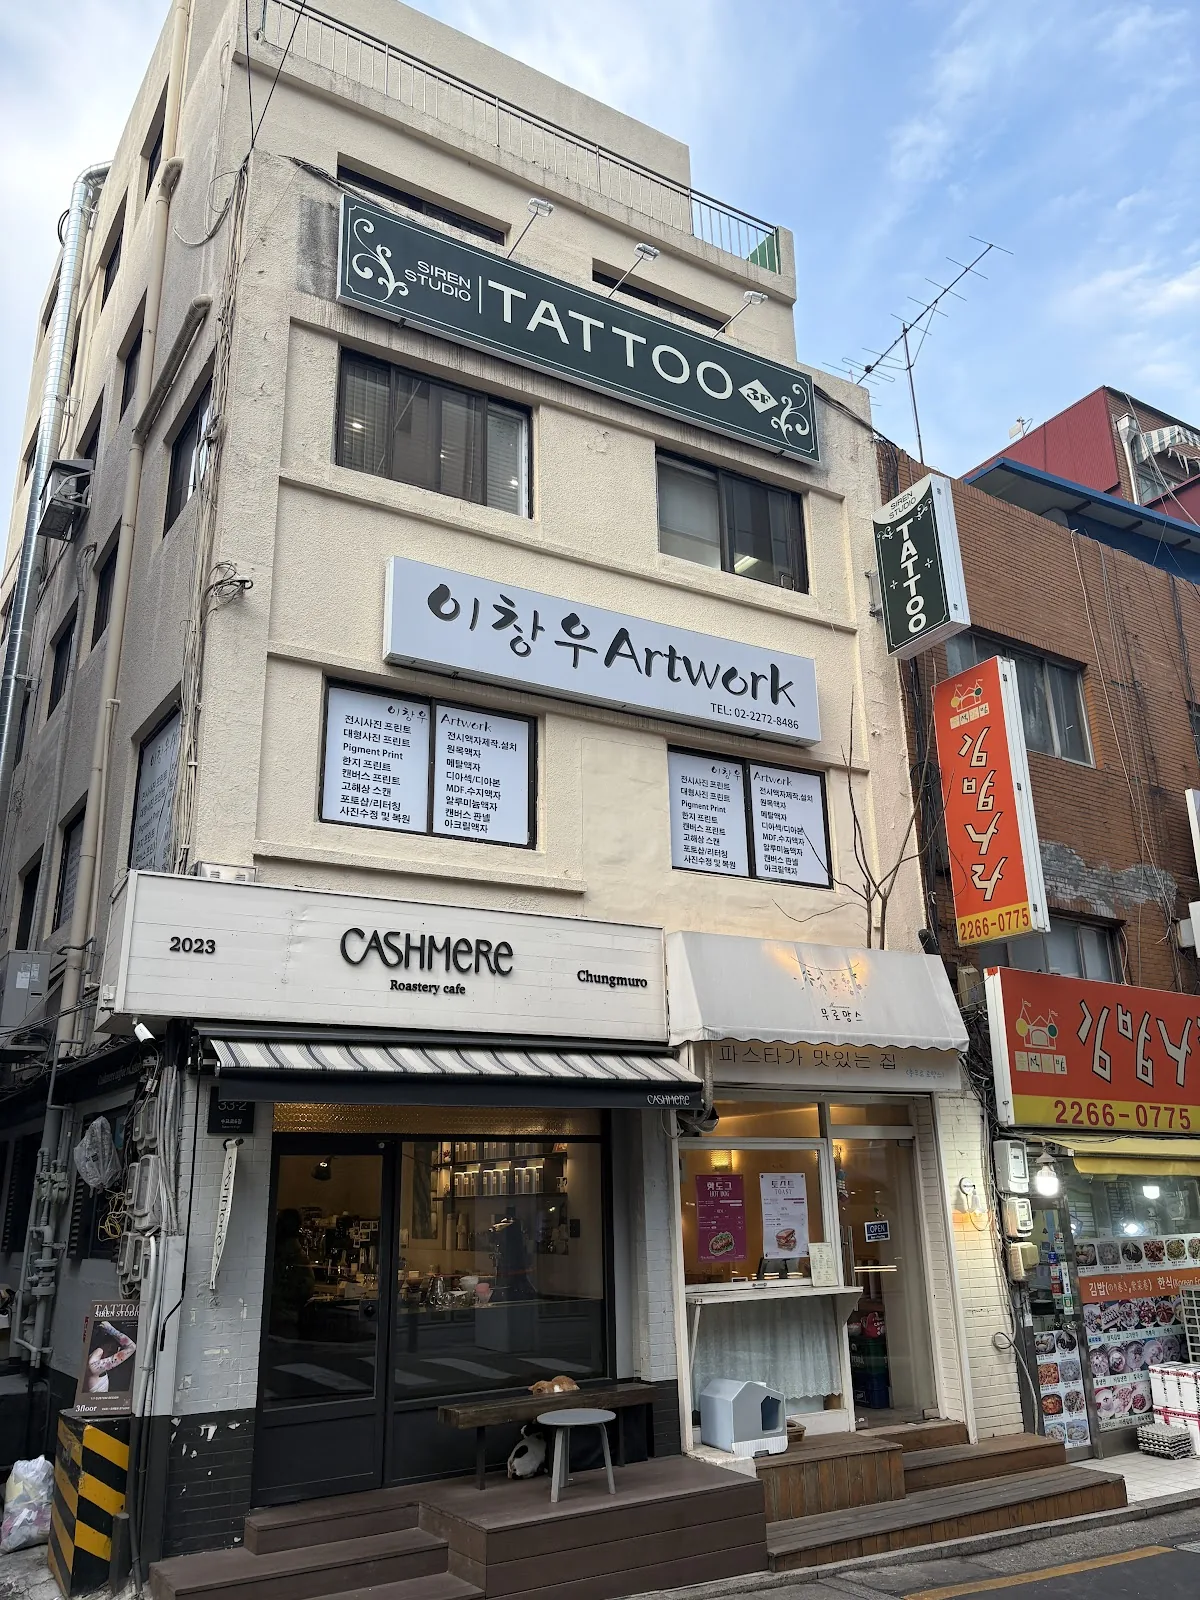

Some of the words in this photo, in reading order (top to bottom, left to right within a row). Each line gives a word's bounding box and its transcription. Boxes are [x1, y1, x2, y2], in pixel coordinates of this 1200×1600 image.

[417, 259, 471, 289] SIREN
[404, 269, 472, 303] STUDIO
[487, 279, 733, 401] TATTOO
[746, 386, 772, 405] 3F
[888, 497, 917, 520] STUDIO
[890, 490, 914, 510] SIREN
[896, 517, 927, 634] TATTOO
[427, 583, 598, 669] 이창우
[604, 627, 796, 708] Artwork
[388, 705, 428, 724] 이창우
[441, 713, 492, 732] Artwork
[710, 702, 731, 718] TEL:
[734, 708, 800, 730] 02-2272-8486
[345, 714, 382, 730] 전시사진
[384, 722, 412, 735] 프린트
[343, 728, 381, 743] 대형사진
[383, 735, 411, 748] 프린트
[343, 742, 380, 756] Pigment
[382, 749, 404, 760] Print
[342, 756, 361, 768] 한지
[363, 759, 391, 772] 프린트
[342, 768, 371, 781] 캔버스
[372, 773, 401, 785] 프린트
[681, 775, 708, 787] 전시사진
[710, 780, 730, 790] 프린트
[711, 766, 741, 781] 이창우
[754, 771, 793, 786] Artwork
[341, 781, 370, 794] 고해상
[372, 786, 392, 798] 스캔
[710, 792, 730, 802] 프린트
[340, 794, 401, 812] 포토샵/리터칭
[681, 799, 709, 811] Pigment
[710, 804, 726, 813] Print
[340, 806, 378, 820] 사진수정
[381, 811, 390, 822] 및
[445, 808, 471, 820] 캔버스
[697, 814, 718, 824] 프린트
[444, 819, 488, 833] 아크릴액자
[705, 825, 726, 835] 프린트
[683, 833, 704, 844] 고해상
[684, 855, 712, 866] 사진수정
[960, 906, 1029, 942] 2266-0775
[169, 935, 216, 955] 2023
[576, 969, 649, 990] Chungmuro
[390, 979, 439, 996] Roastery
[443, 981, 466, 995] cafe
[1076, 999, 1200, 1088] 김밥사
[719, 1045, 803, 1068] 파스타가
[812, 1049, 871, 1070] 맛있는
[880, 1052, 896, 1070] 집
[1054, 1099, 1191, 1130] 2266-0775
[706, 1181, 733, 1191] 핫도그
[771, 1180, 795, 1189] 토스트
[870, 1224, 885, 1234] OPEN
